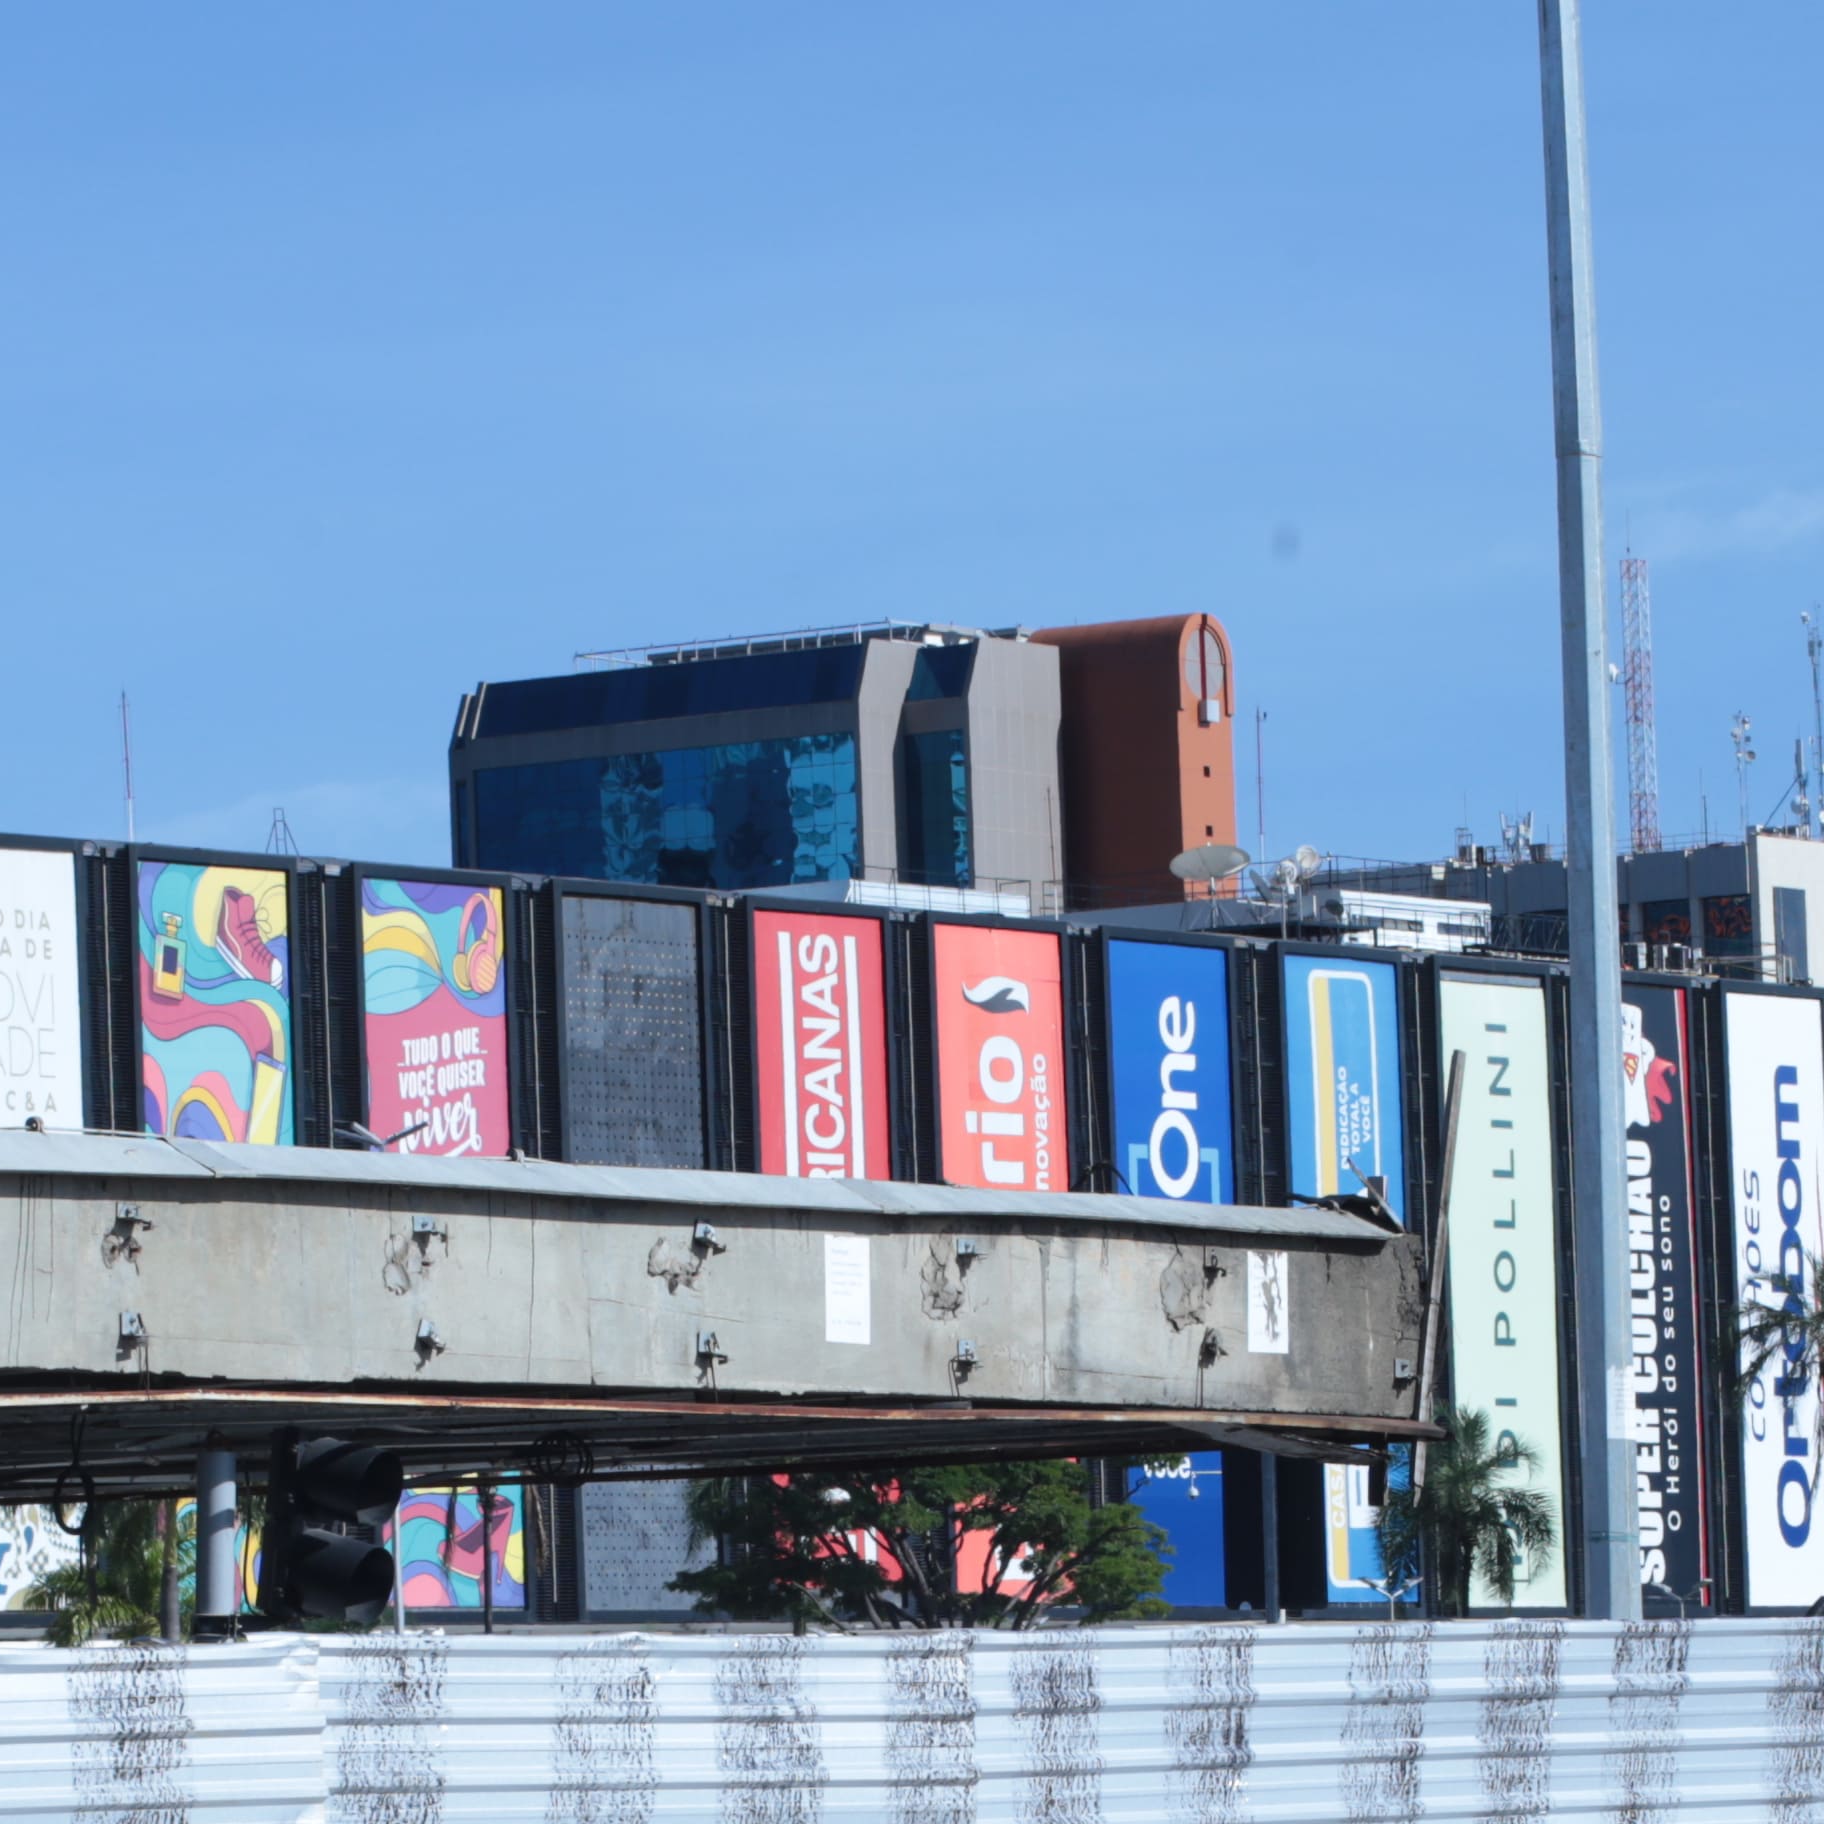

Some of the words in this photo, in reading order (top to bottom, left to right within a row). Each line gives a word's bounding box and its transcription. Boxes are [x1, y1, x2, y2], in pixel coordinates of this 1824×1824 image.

[13, 908, 52, 930] DIA
[24, 938, 54, 961] DE
[401, 1035, 439, 1067] TUDO
[441, 1032, 452, 1060] O
[454, 1027, 481, 1061] QUE
[437, 1059, 487, 1097] QUISER
[1148, 995, 1201, 1199] One
[1349, 1082, 1360, 1095] A
[5, 1089, 58, 1113] C&A
[1349, 1102, 1361, 1155] TOTAL
[1483, 1022, 1519, 1348] POLLINI
[1658, 1194, 1674, 1272] sono
[1661, 1285, 1676, 1340] seu
[1742, 1169, 1768, 1442] COHÕES
[1662, 1353, 1678, 1393] do
[1663, 1407, 1681, 1494] Herói
[1667, 1510, 1682, 1532] O
